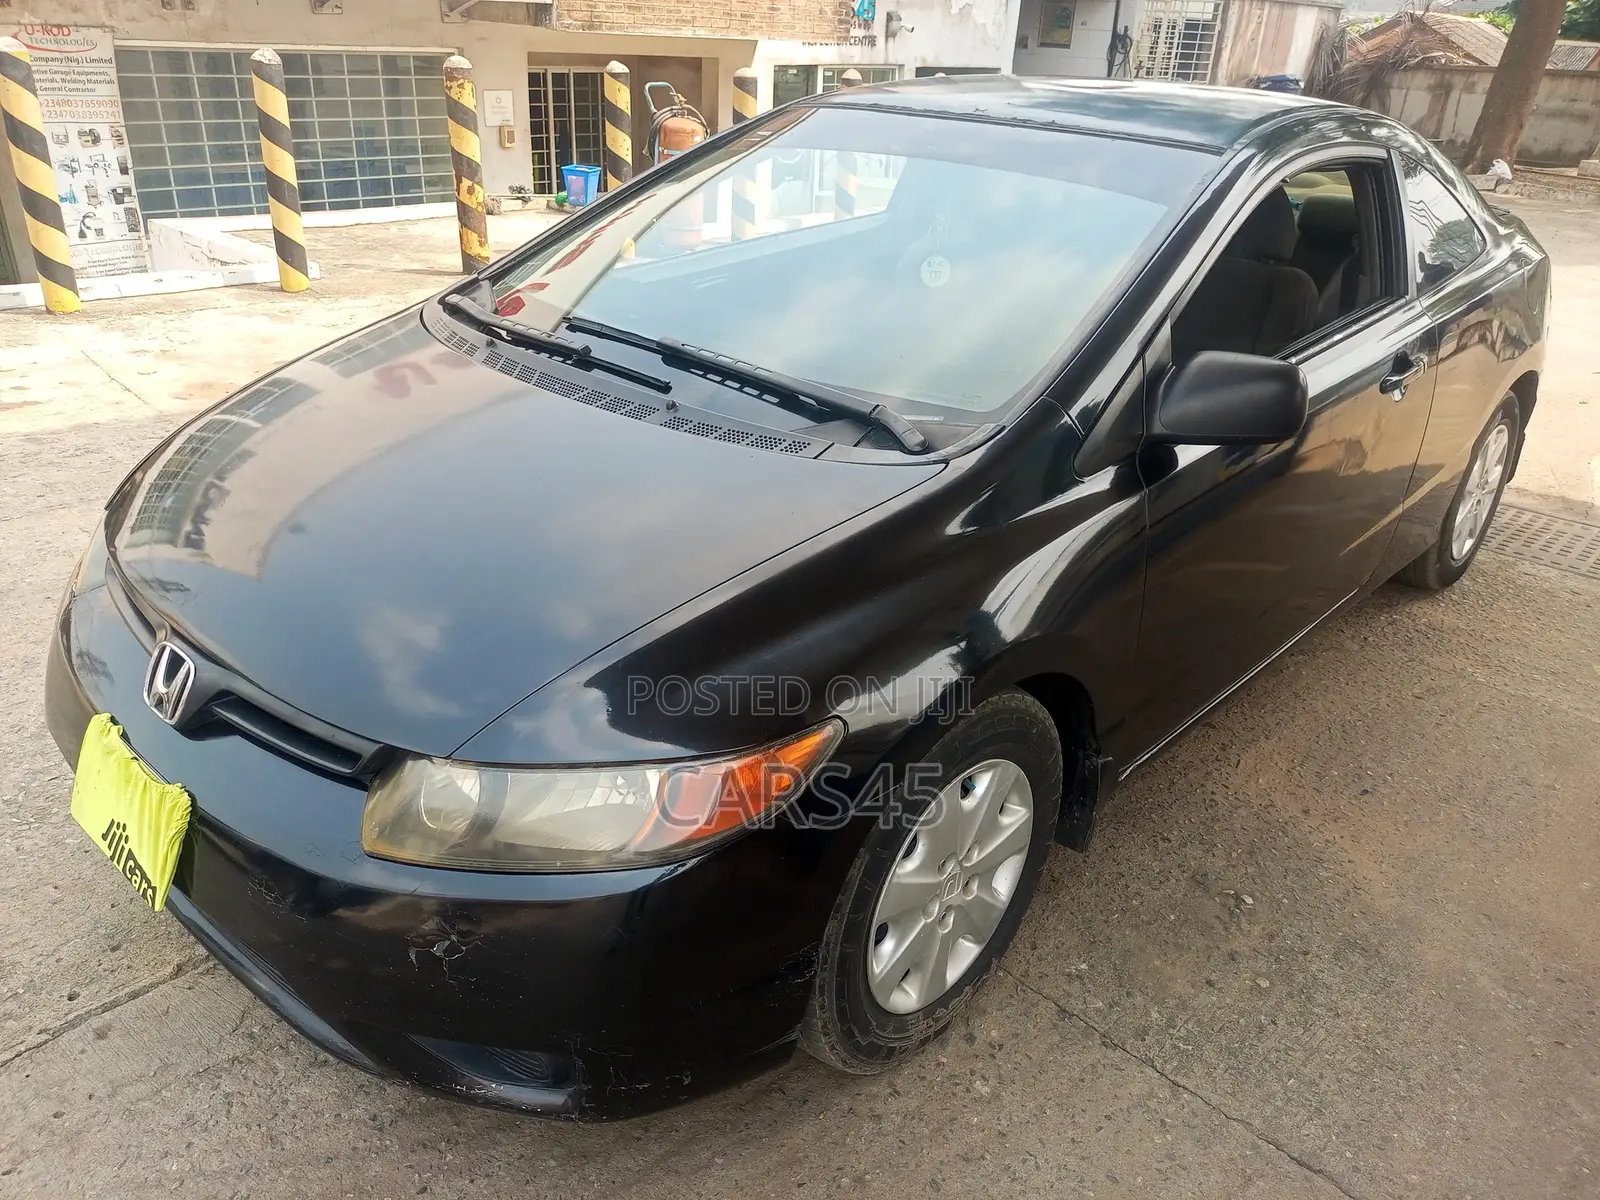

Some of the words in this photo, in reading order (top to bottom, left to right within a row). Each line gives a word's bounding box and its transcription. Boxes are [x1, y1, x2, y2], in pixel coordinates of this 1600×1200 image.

[849, 36, 877, 47] CENTRE
[30, 55, 63, 65] Company
[85, 57, 113, 65] Limited
[61, 78, 86, 86] Welding
[101, 818, 129, 867] Jiji
